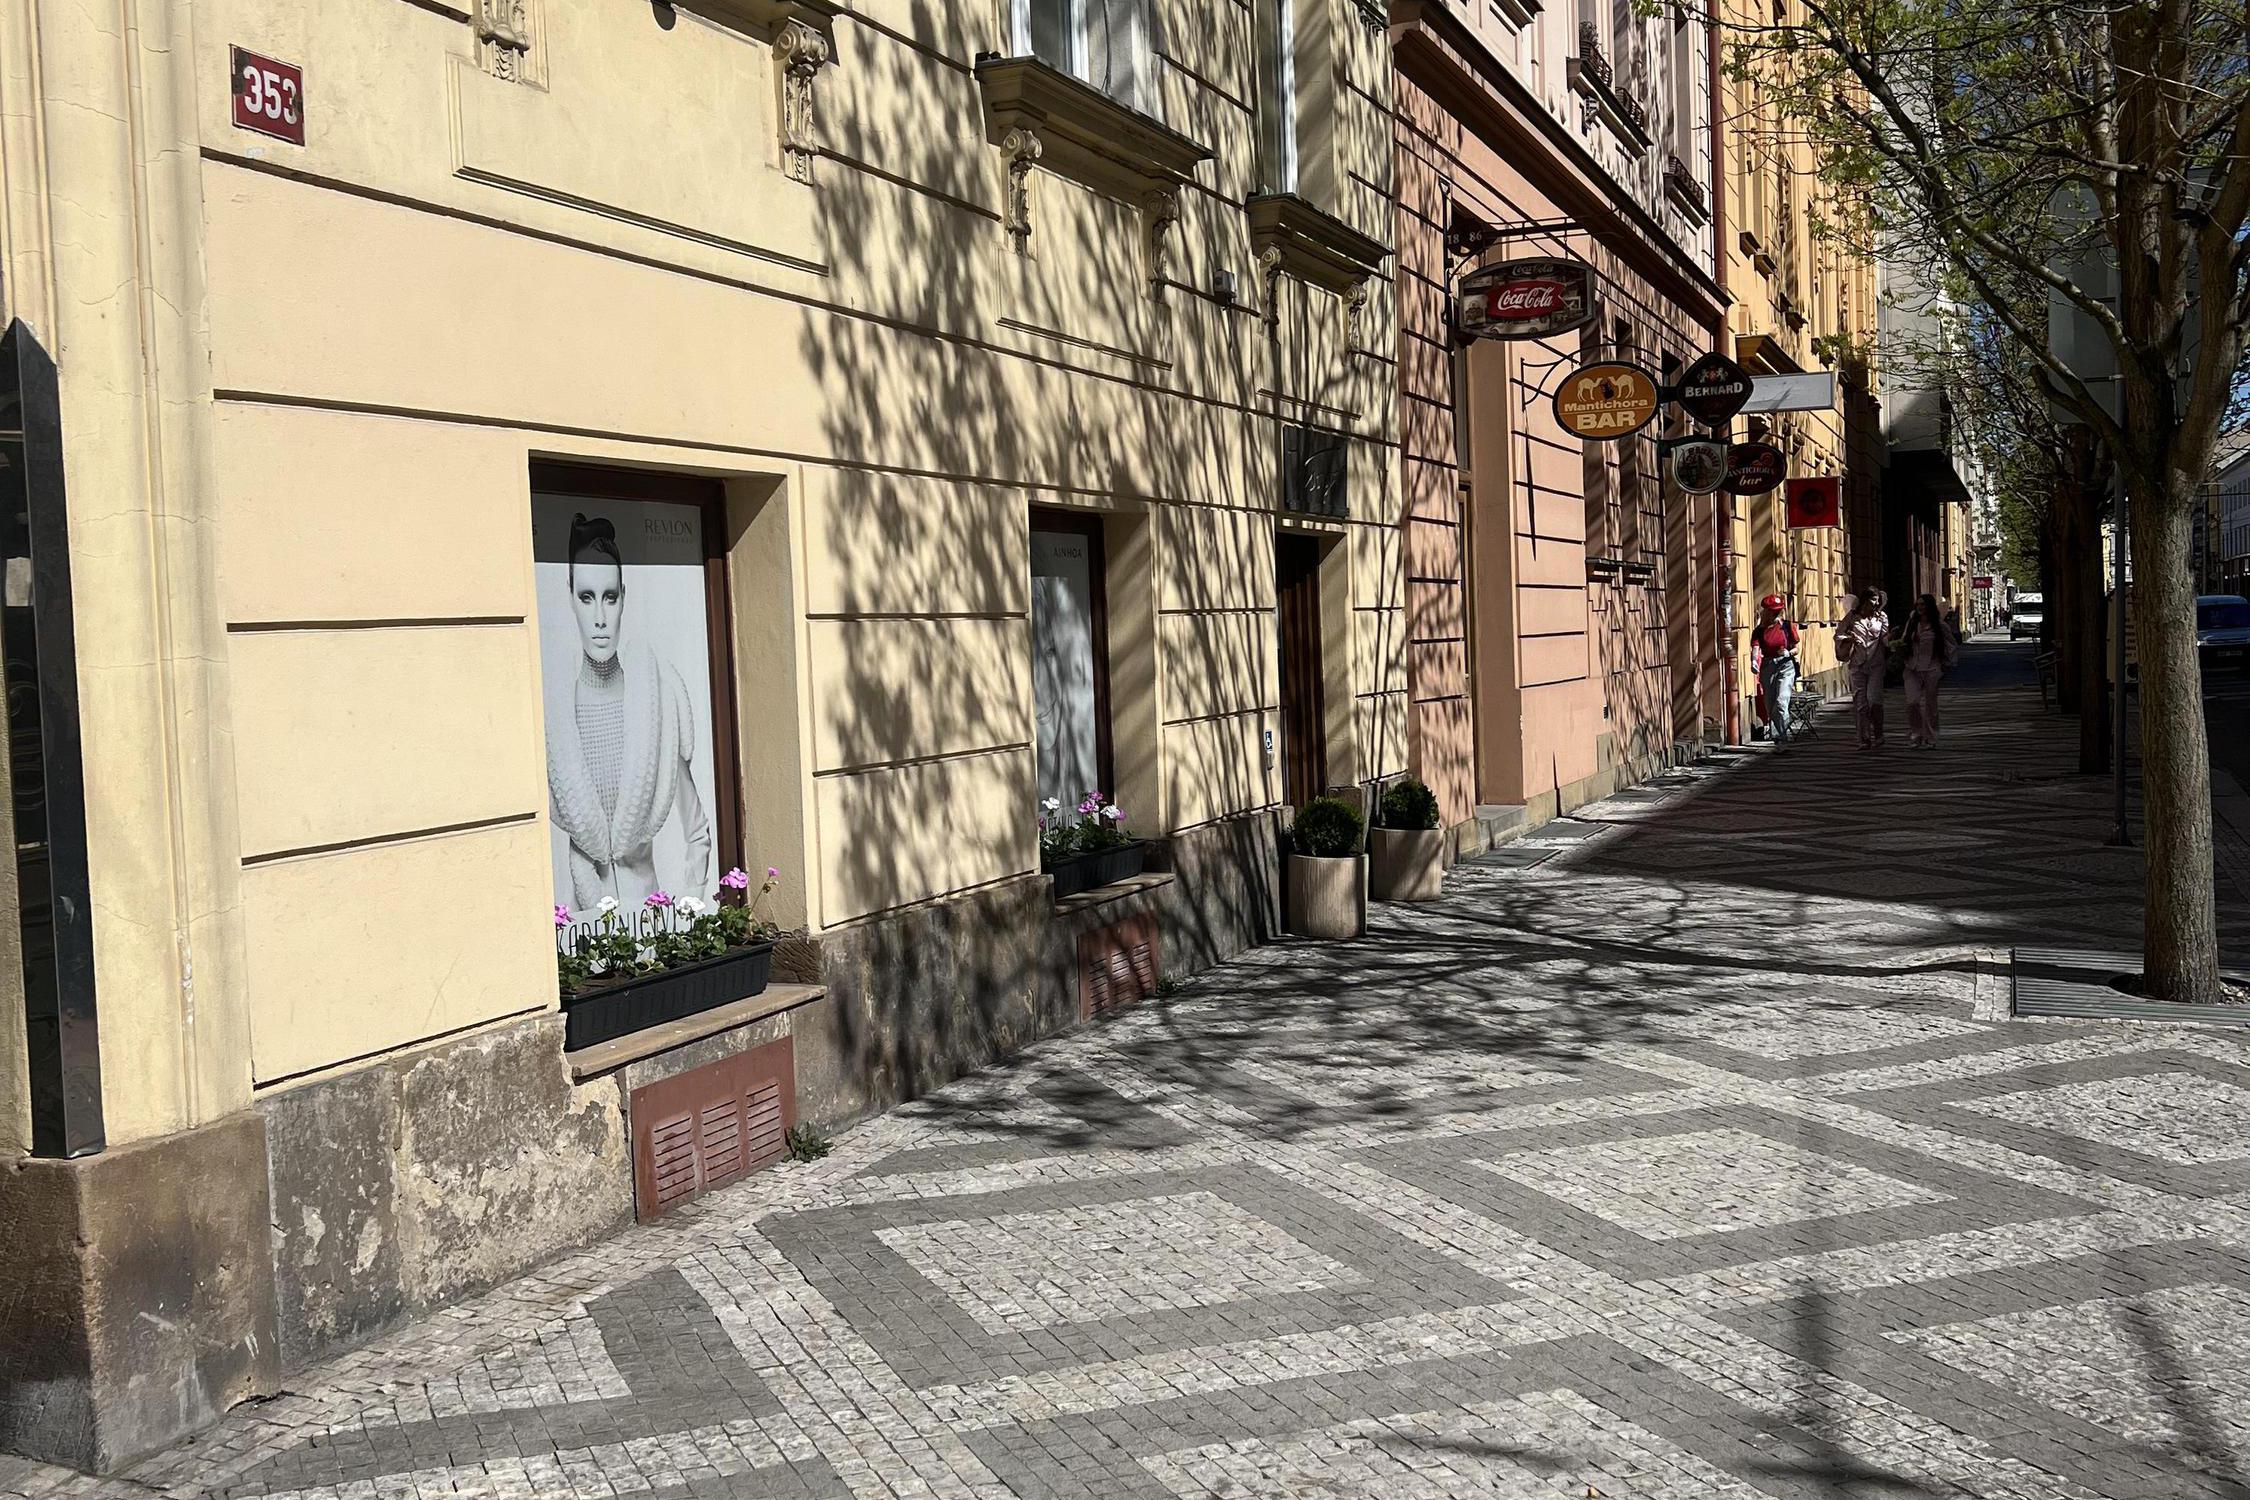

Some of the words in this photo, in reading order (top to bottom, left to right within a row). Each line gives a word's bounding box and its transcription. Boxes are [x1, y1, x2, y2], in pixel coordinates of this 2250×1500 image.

[243, 65, 297, 124] 353
[1497, 287, 1555, 310] Coca-Cola
[1685, 382, 1743, 398] BERNARD
[1564, 399, 1648, 412] Mantichora
[1577, 411, 1636, 430] BAR
[1739, 474, 1762, 486] bar
[644, 518, 693, 536] REVLON
